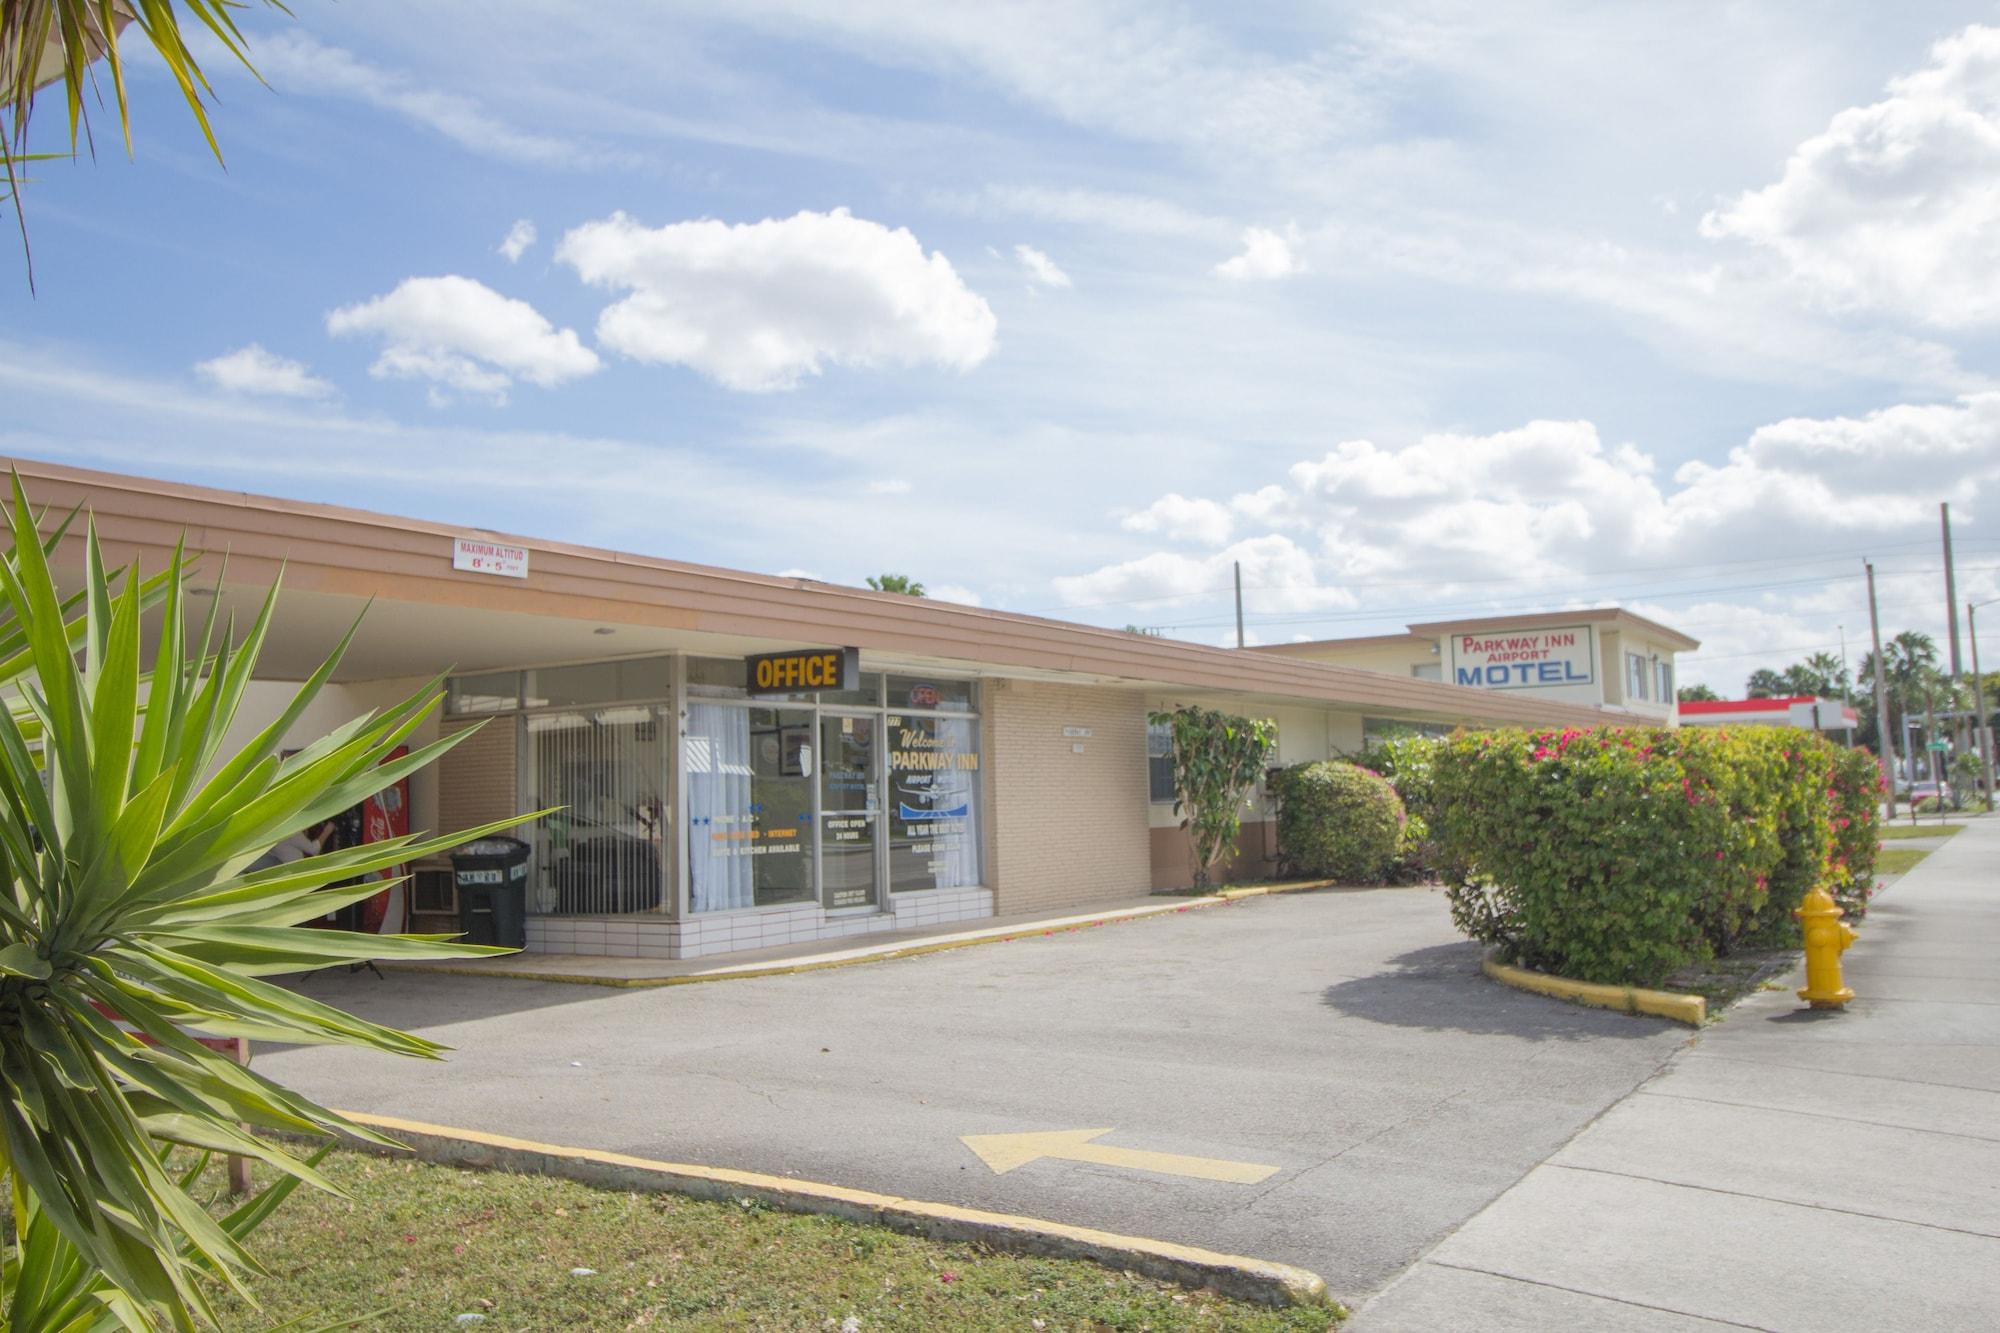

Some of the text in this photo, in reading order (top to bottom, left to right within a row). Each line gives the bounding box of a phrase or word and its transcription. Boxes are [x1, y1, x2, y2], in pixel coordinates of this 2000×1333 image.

[461, 543, 523, 560] MAXIMUM ALTITUD
[1463, 633, 1575, 654] PARKWAY INN
[1487, 650, 1550, 664] AIRPORT
[757, 655, 837, 688] OFFICE
[1457, 660, 1588, 686] MOTEL
[900, 728, 945, 749] Welcome
[892, 751, 978, 770] PARKWAY INN
[828, 819, 866, 829] OFFICE OPEN
